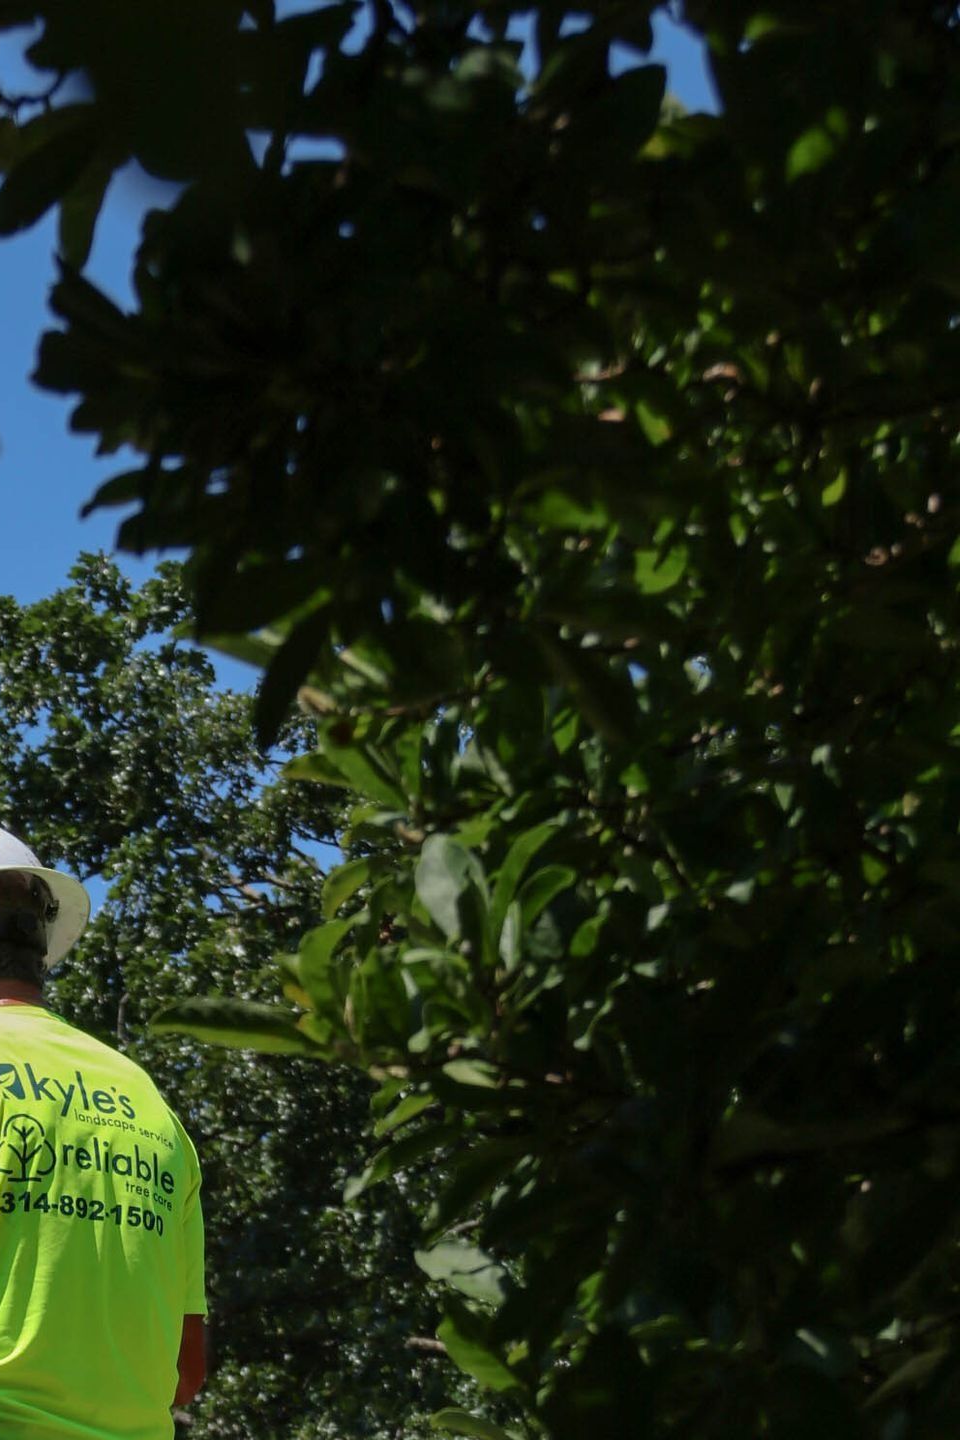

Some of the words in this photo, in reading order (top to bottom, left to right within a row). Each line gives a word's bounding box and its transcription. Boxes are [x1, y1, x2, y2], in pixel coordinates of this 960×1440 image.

[24, 1062, 136, 1120] kyle's
[74, 1108, 136, 1132] landscape
[138, 1127, 173, 1151] service
[62, 1136, 175, 1195] reliable
[0, 1191, 164, 1237] 314-892-1500
[125, 1181, 150, 1198] tree
[152, 1193, 173, 1212] care
